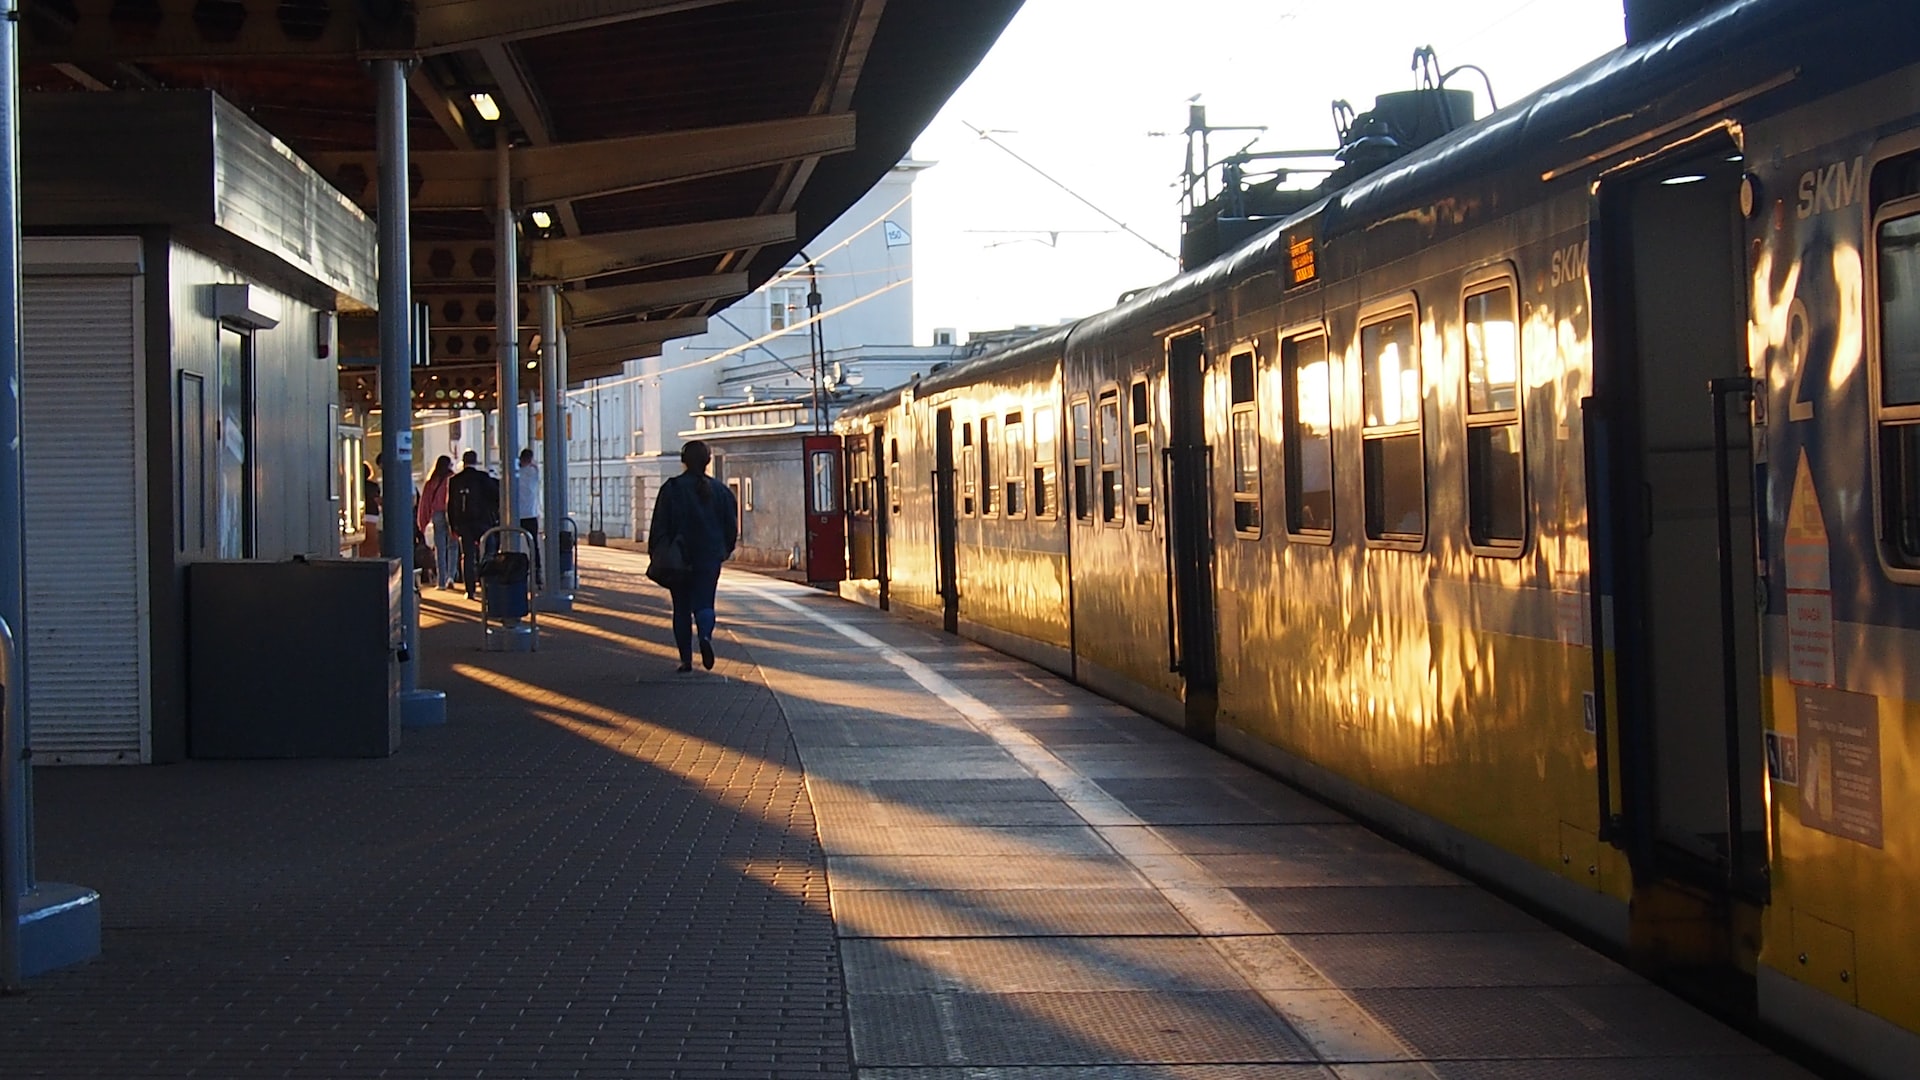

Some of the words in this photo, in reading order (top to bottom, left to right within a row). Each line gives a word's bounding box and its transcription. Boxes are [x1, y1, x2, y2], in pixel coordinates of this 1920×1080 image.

[1797, 155, 1864, 220] SKM
[1551, 239, 1589, 288] SKM
[1786, 297, 1814, 422] 2
